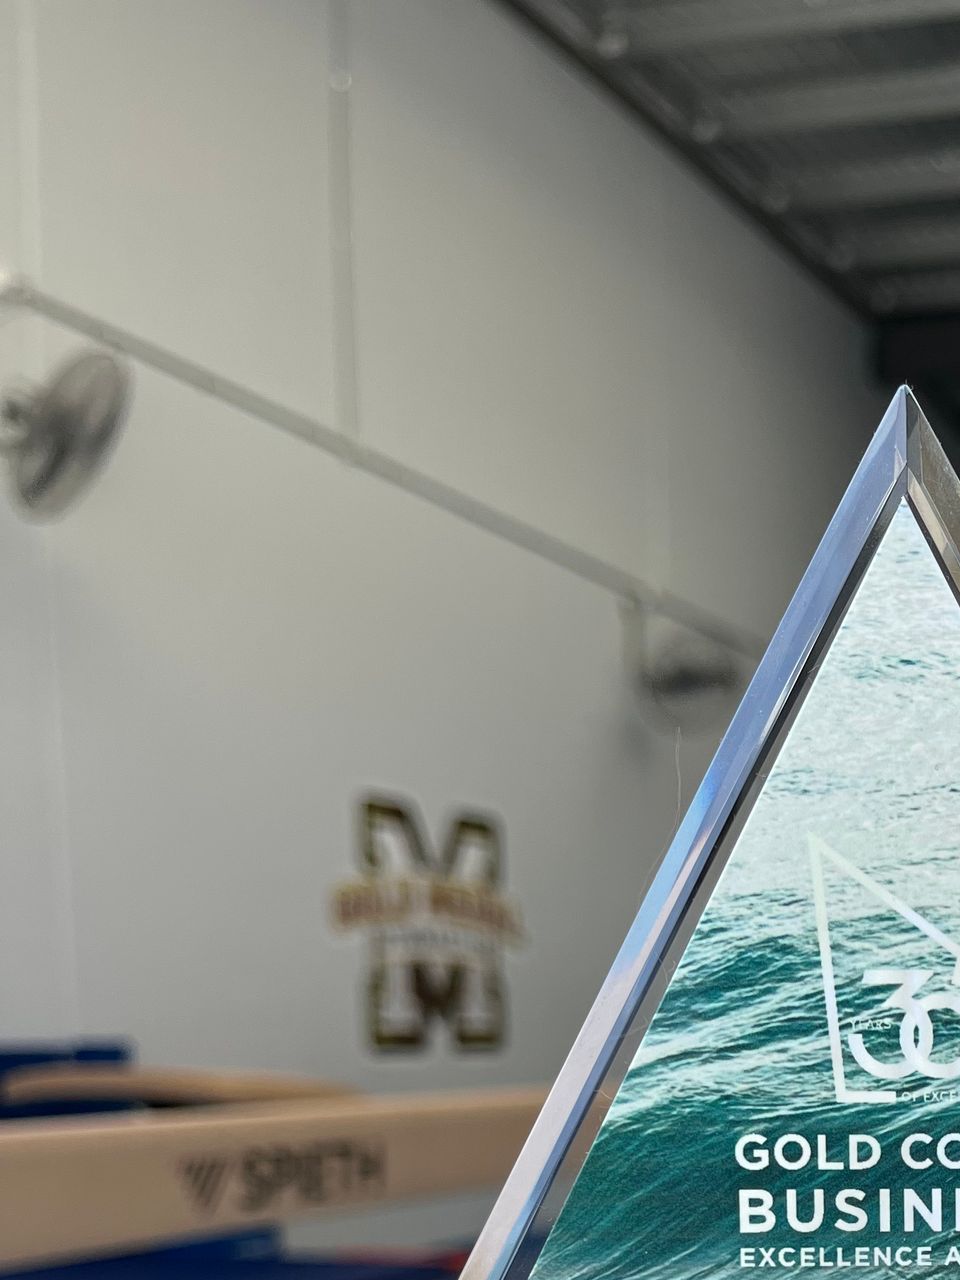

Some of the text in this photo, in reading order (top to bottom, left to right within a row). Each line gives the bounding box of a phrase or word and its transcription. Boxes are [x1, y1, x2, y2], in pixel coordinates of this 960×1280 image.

[850, 1019, 892, 1031] YARS
[734, 1132, 881, 1171] GOLD
[739, 1246, 932, 1268] EXCELLENCE
